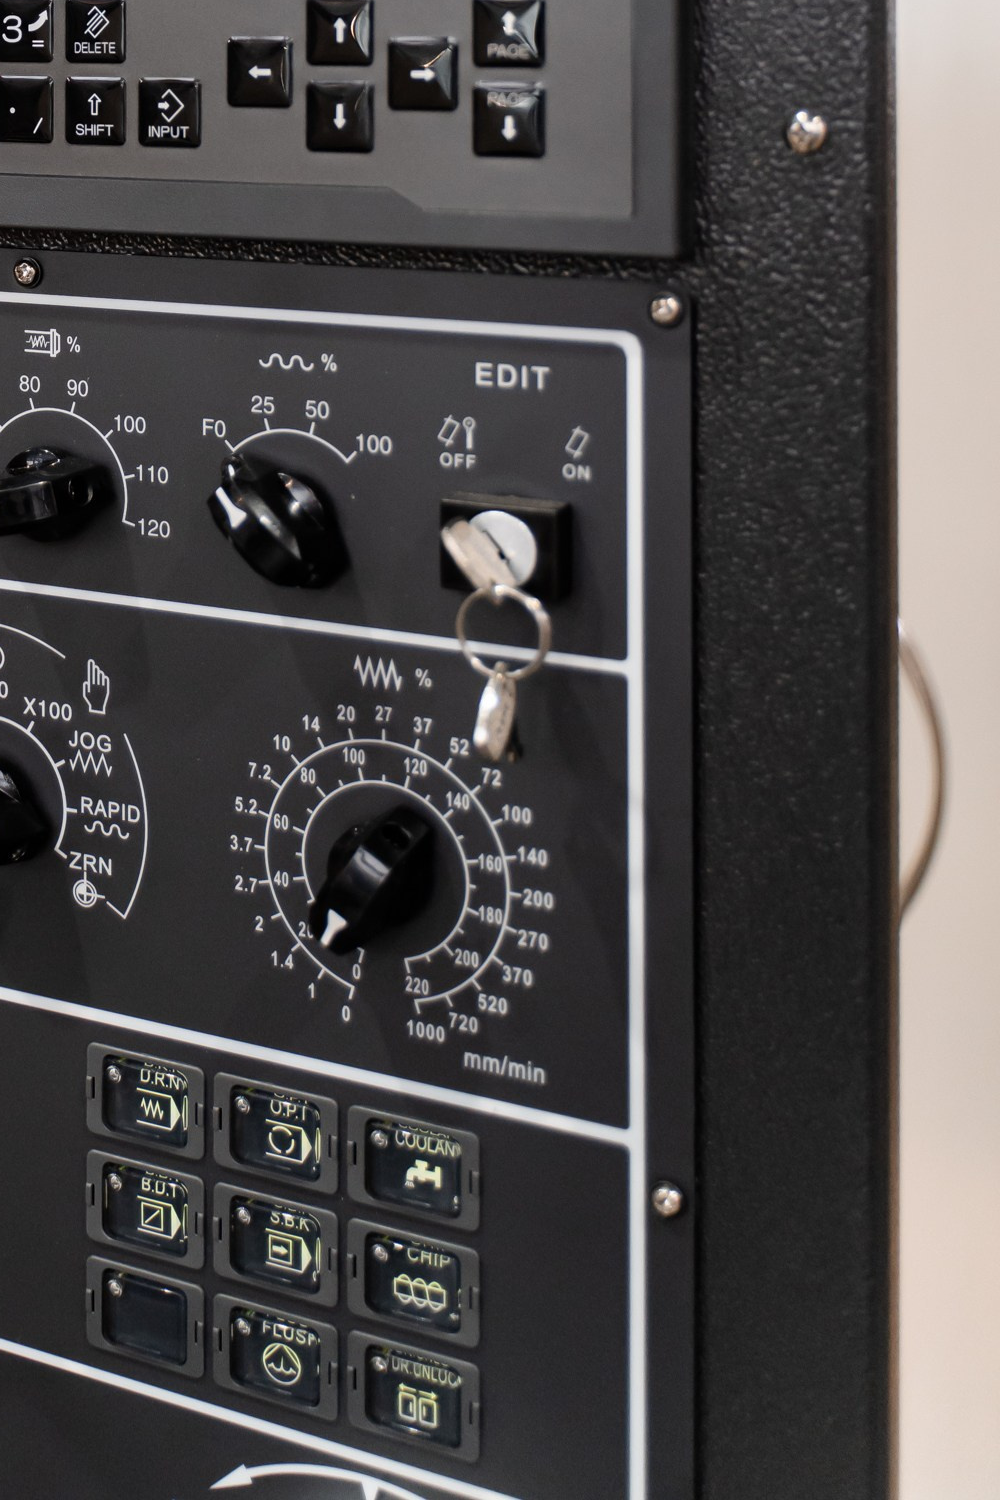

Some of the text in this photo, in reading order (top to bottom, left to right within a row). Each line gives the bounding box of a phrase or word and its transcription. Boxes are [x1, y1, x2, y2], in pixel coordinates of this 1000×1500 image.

[74, 42, 116, 54] DELETE
[75, 124, 114, 137] SHIFT
[148, 126, 189, 139] INPUT
[19, 375, 41, 393] 80
[474, 361, 550, 390] EDIT
[67, 379, 89, 397] 90
[251, 395, 275, 415] 25
[305, 400, 329, 420] 50
[114, 415, 146, 434] 100
[355, 434, 392, 455] 100
[439, 452, 477, 469] OFF
[136, 465, 169, 483] 110
[562, 464, 592, 481] ON
[138, 519, 170, 538] 120
[23, 696, 72, 722] X100
[338, 705, 356, 723] 20
[375, 705, 393, 722] 27
[302, 715, 320, 732] 14
[413, 717, 432, 735] 37
[68, 730, 112, 752] JOG
[273, 735, 290, 752] 10
[449, 737, 469, 756] 52
[342, 748, 366, 765] 100
[248, 762, 271, 781] 7.2
[300, 768, 316, 784] 80
[404, 758, 428, 776] 120
[482, 767, 501, 786] 72
[81, 796, 140, 823] RAPID
[235, 797, 257, 815] 5.2
[446, 792, 470, 811] 140
[273, 814, 288, 830] 60
[502, 804, 532, 824] 100
[230, 834, 252, 852] 3.7
[69, 851, 112, 876] ZRN
[478, 854, 502, 872] 160
[518, 847, 548, 867] 140
[235, 875, 257, 893] 2.7
[274, 871, 289, 888] 40
[523, 891, 554, 910] 200
[478, 906, 502, 924] 180
[518, 930, 549, 951] 270
[271, 951, 293, 969] 1.4
[455, 950, 479, 968] 200
[405, 976, 429, 995] 220
[502, 966, 533, 987] 370
[478, 995, 508, 1014] 520
[407, 1020, 445, 1042] 1000
[449, 1012, 478, 1034] 720
[463, 1050, 546, 1084] mm/min
[407, 1247, 450, 1267] CHIP
